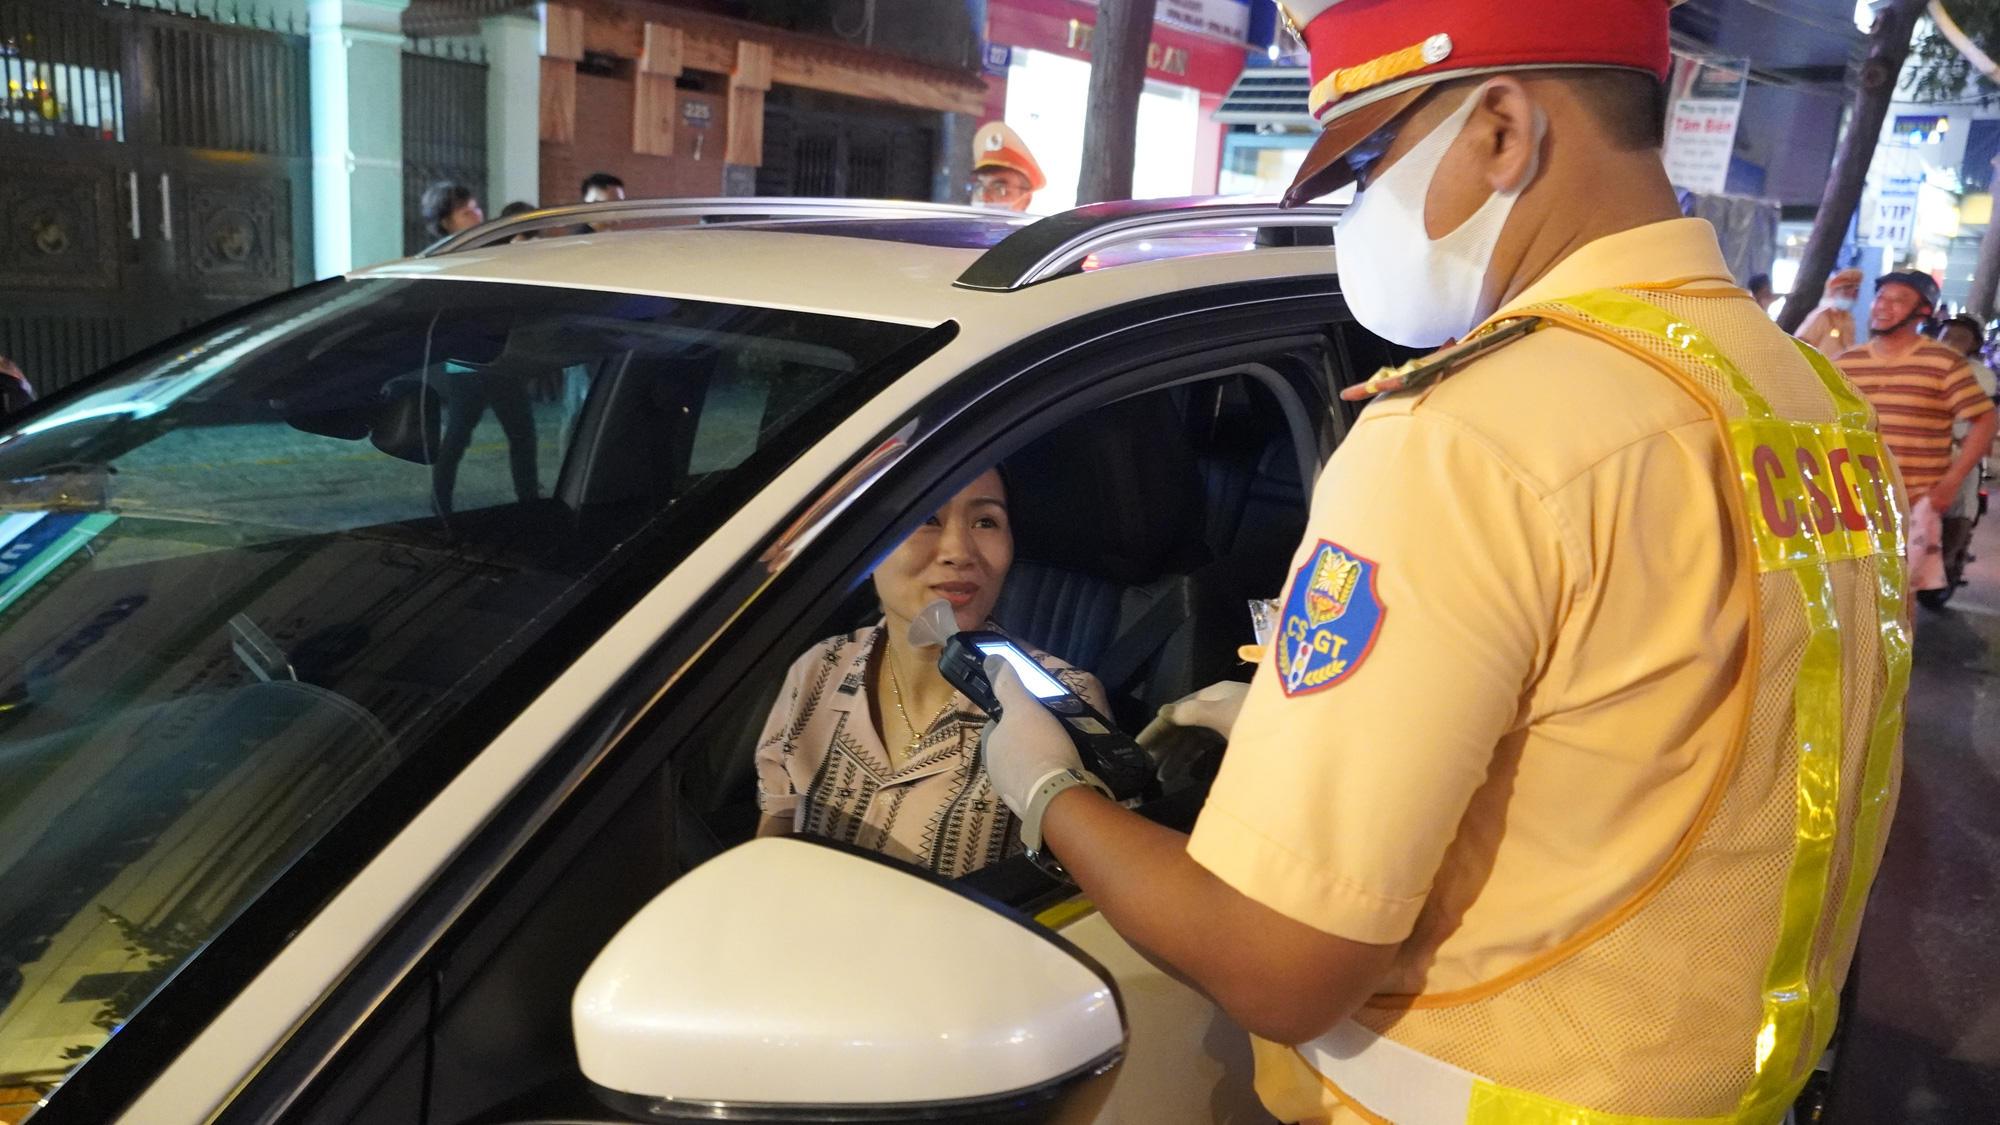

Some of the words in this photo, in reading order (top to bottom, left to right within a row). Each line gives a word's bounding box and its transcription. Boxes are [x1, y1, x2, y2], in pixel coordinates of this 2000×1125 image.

[1881, 205, 1911, 220] VIP
[1287, 615, 1309, 642] CS
[1314, 629, 1348, 659] GT
